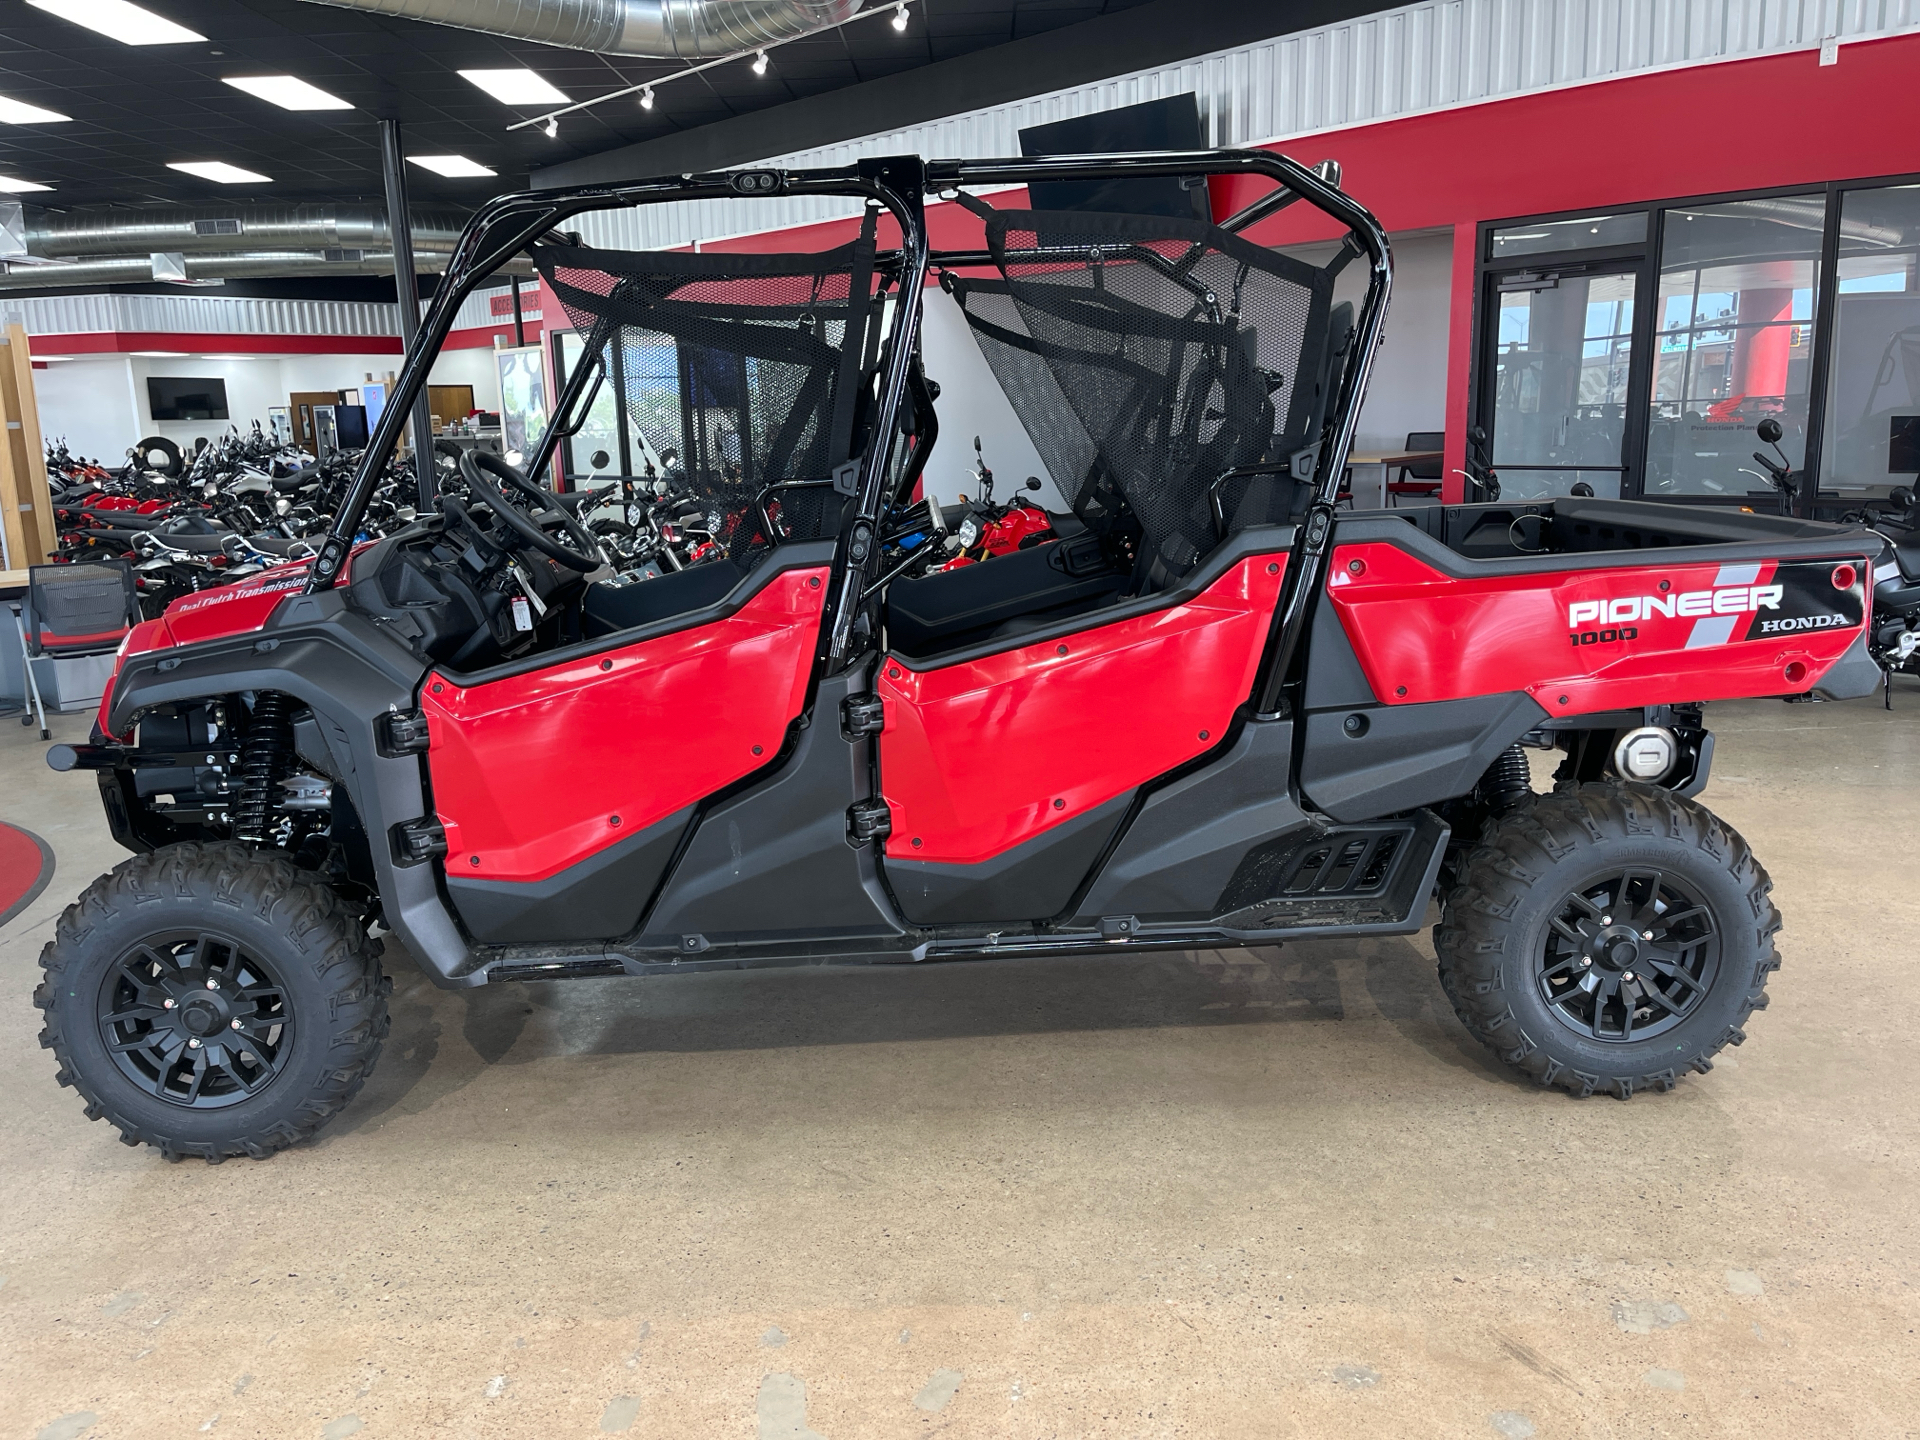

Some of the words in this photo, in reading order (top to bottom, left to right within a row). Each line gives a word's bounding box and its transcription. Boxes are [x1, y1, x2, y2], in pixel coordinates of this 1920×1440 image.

[493, 293, 539, 312] ACCESORIES
[201, 591, 234, 608] Clutch
[235, 577, 308, 600] Transmission
[1569, 584, 1783, 628] PIONEER
[1761, 614, 1850, 632] HONDA
[1569, 627, 1638, 647] 1000
